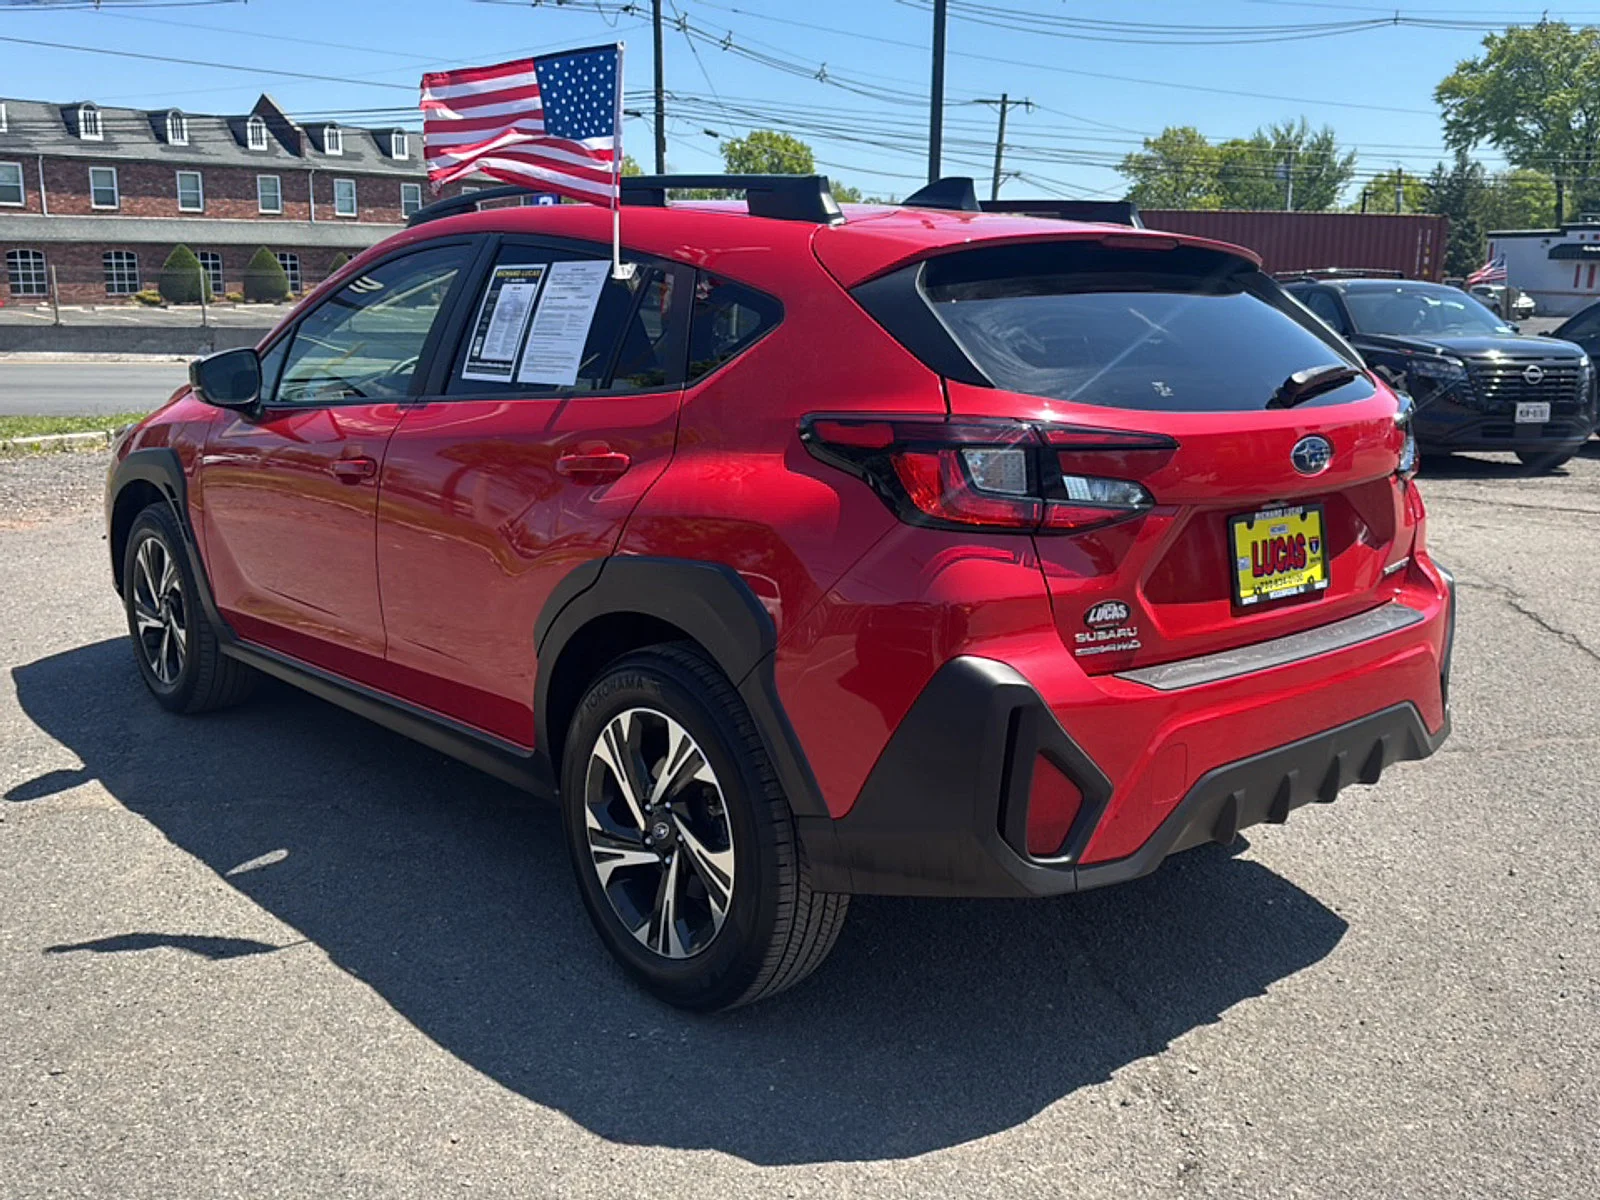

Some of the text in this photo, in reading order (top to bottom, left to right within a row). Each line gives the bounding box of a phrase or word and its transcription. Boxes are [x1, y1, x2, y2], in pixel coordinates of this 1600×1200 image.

[1252, 532, 1307, 577] LUCAS
[1087, 605, 1127, 623] LUCAS
[1075, 627, 1137, 643] SUBARU
